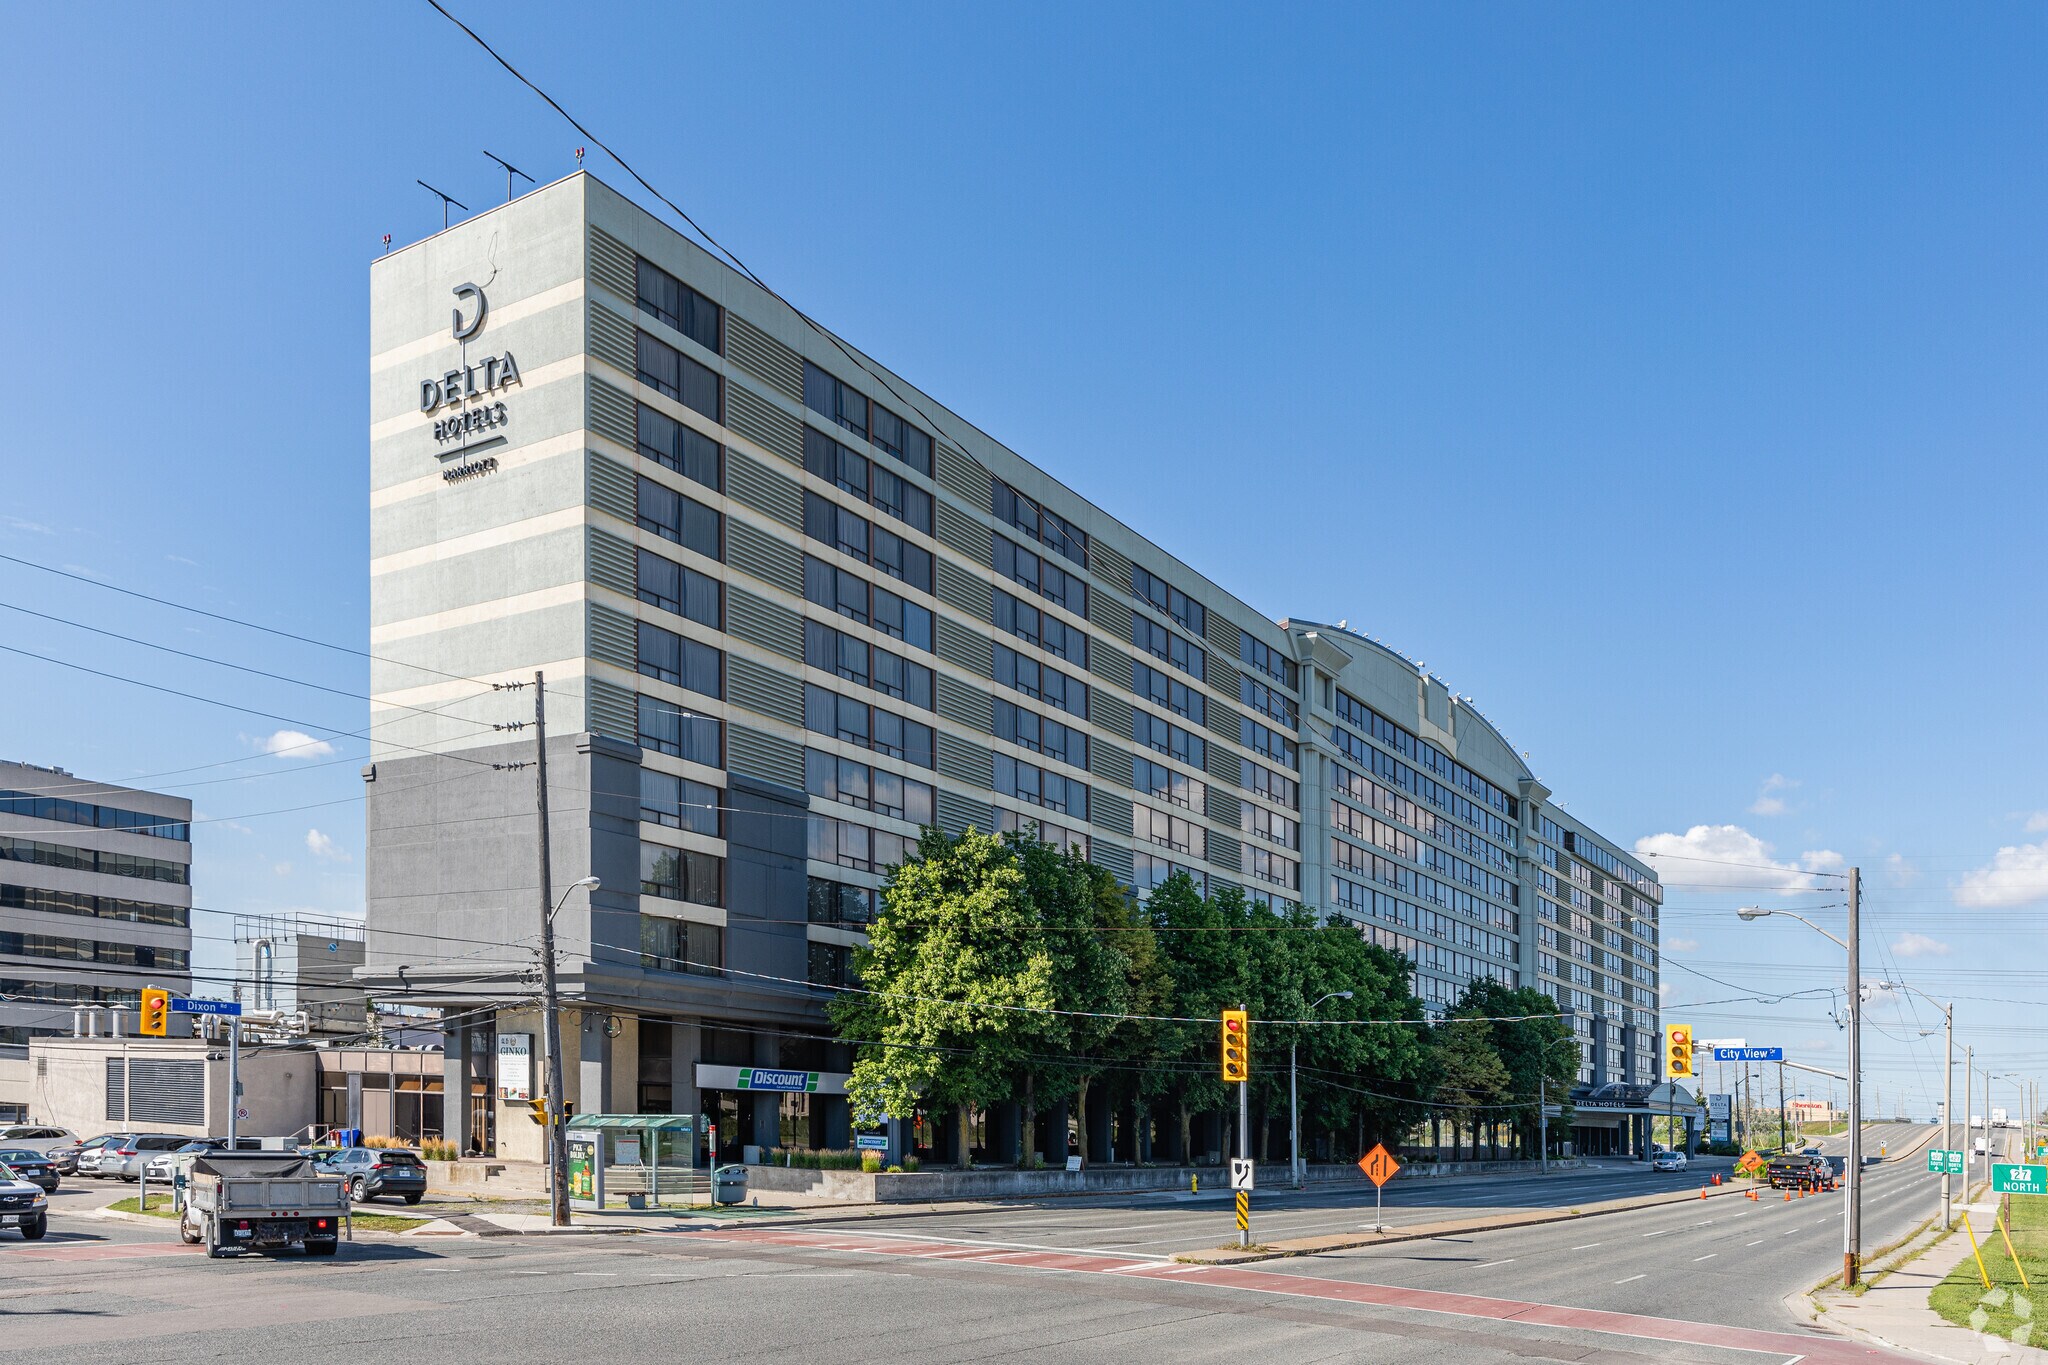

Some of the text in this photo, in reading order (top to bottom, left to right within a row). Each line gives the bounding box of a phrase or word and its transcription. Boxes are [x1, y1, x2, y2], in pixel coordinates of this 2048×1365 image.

[421, 351, 520, 412] DELTA
[434, 401, 507, 440] HOTELS
[443, 457, 497, 480] MARRIOTT
[187, 1001, 216, 1012] Dixon
[501, 1046, 526, 1056] GINKO
[1720, 1049, 1740, 1060] City
[1744, 1049, 1767, 1058] View
[754, 1071, 804, 1086] Discount
[2014, 1171, 2028, 1180] 27
[2003, 1182, 2039, 1193] NORTH
